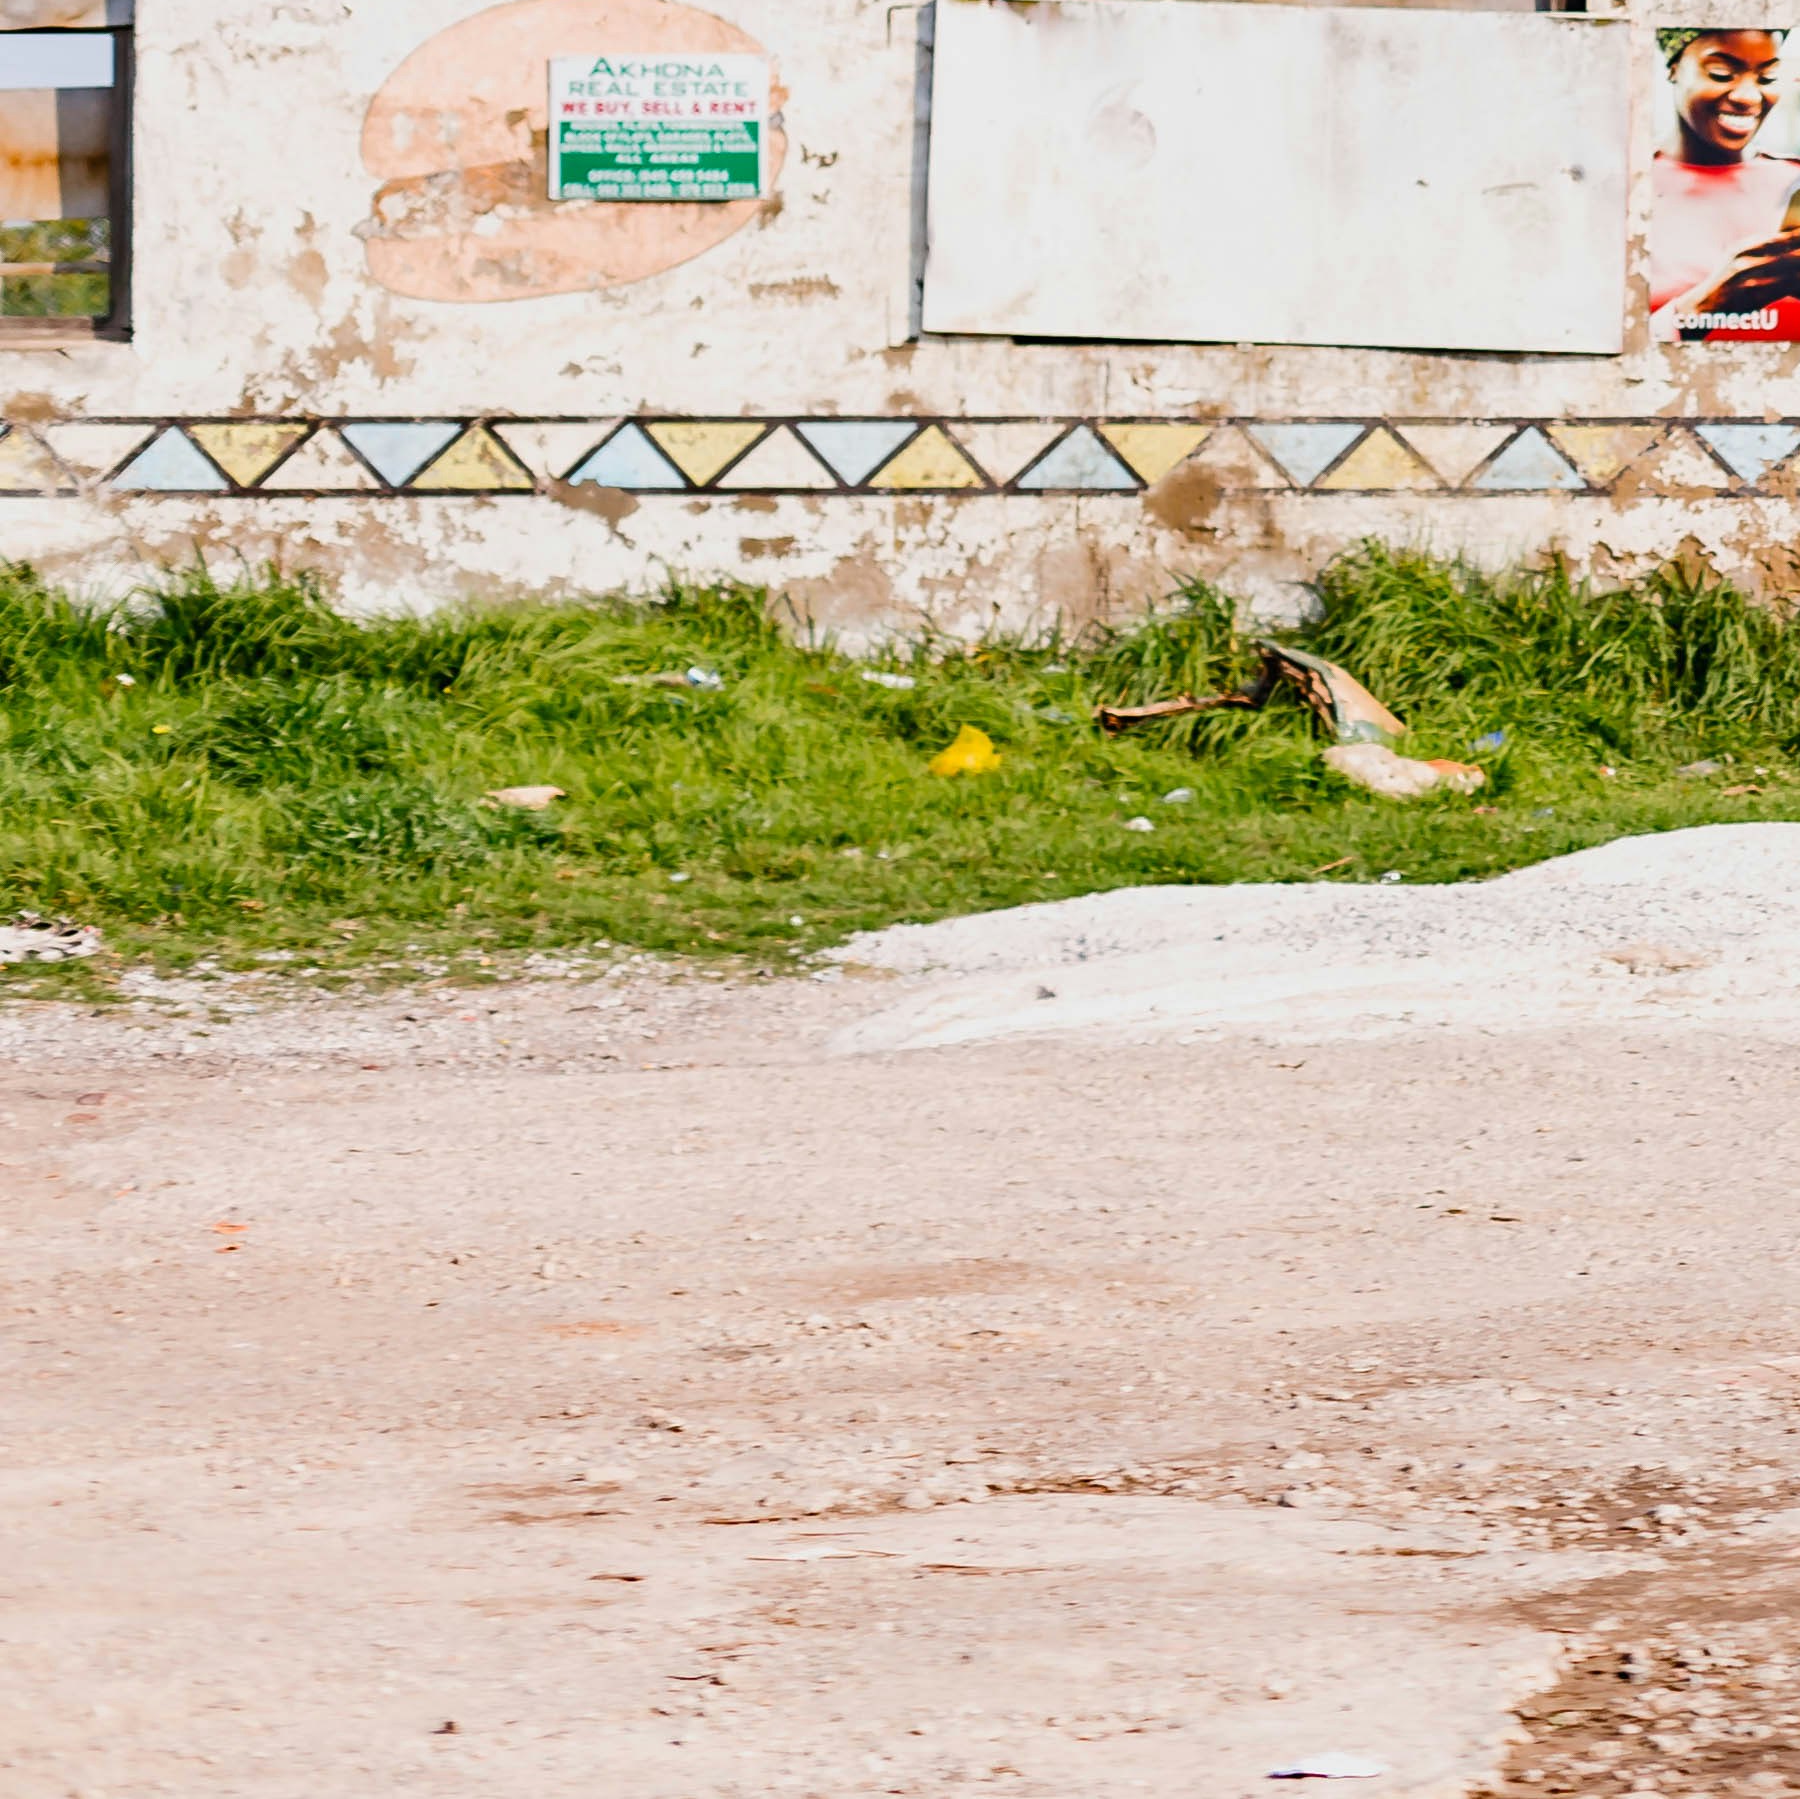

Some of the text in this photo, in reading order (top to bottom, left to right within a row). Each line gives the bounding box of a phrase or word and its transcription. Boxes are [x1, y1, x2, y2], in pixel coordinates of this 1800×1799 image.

[568, 81, 748, 96] REAL ESTATE
[562, 102, 588, 115] WE
[642, 102, 682, 115] SELL
[710, 102, 758, 115] RENT
[1673, 308, 1778, 330] connectU
